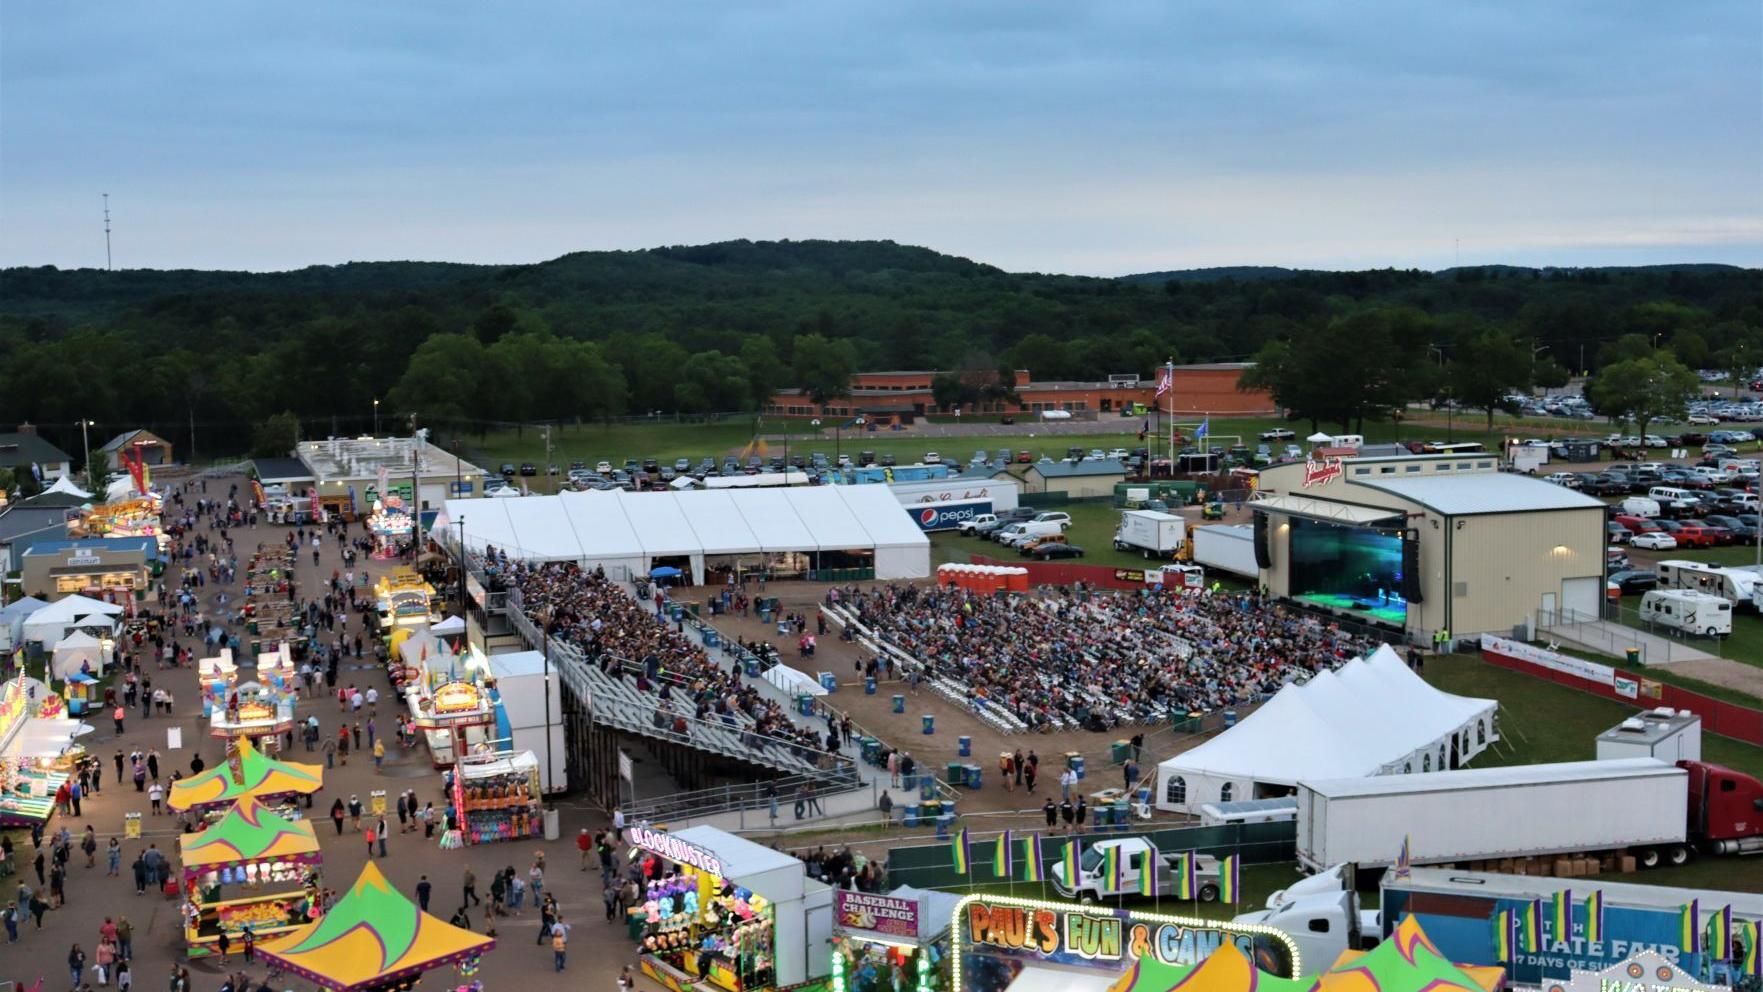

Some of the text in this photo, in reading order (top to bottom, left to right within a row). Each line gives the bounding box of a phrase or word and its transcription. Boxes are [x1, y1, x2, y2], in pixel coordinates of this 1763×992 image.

[940, 508, 974, 523] pepsi
[630, 828, 723, 879] BLOCKBUSTER
[846, 894, 909, 910] BASEBALL
[842, 903, 914, 921] CHALLENGE
[969, 903, 1058, 953] PAUL'S
[1066, 913, 1121, 959] FUN
[1130, 924, 1152, 958] &
[1156, 924, 1254, 968] GAMS
[1528, 956, 1564, 968] DAYS
[1567, 960, 1586, 969] OF
